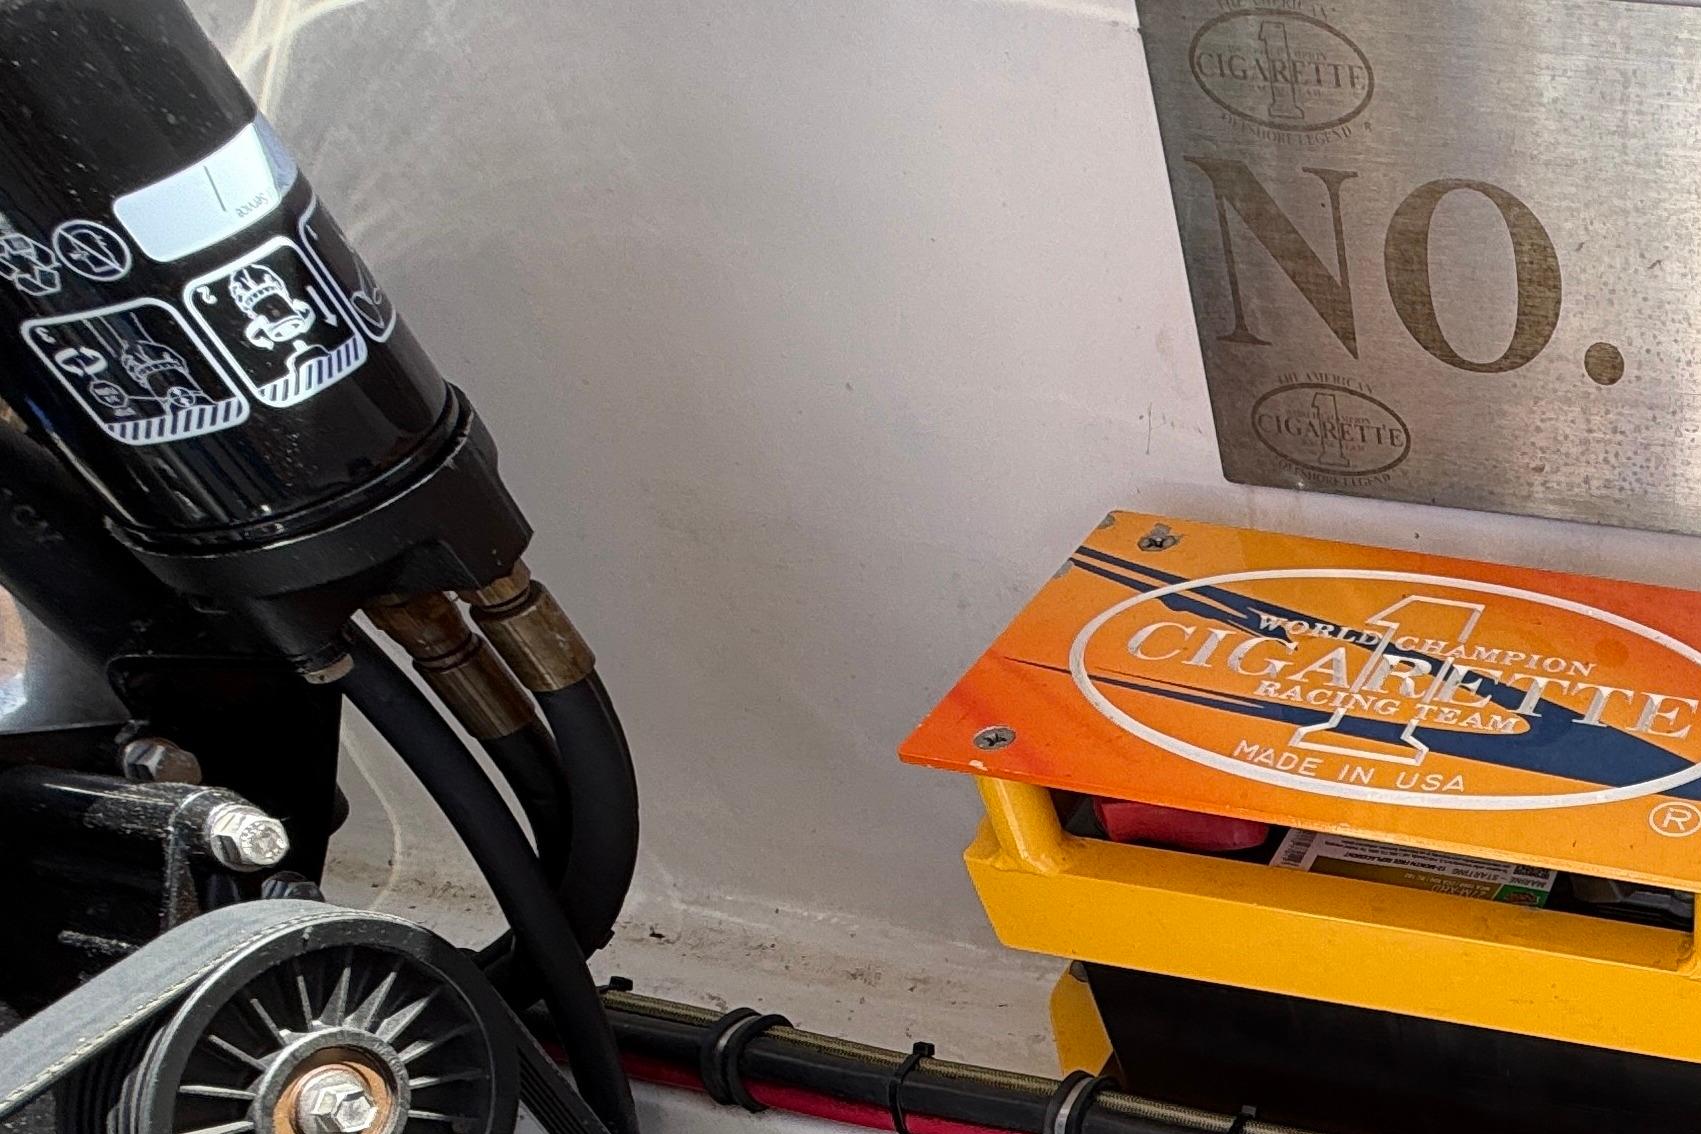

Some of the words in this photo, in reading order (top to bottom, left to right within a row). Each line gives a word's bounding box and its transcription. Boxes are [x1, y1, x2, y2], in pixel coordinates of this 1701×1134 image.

[1196, 52, 1367, 91] CIGARETTE
[1183, 156, 1626, 386] NO.
[1257, 413, 1405, 448] CIGARETTE
[1252, 609, 1386, 646] WORLD
[1395, 635, 1597, 677] CHAMPION
[1127, 621, 1700, 740] CIGARETTE
[1253, 679, 1400, 717] RACING
[1414, 701, 1519, 734] TEAM
[1233, 738, 1325, 777] MADE
[1337, 763, 1376, 785] IN
[1393, 770, 1466, 794] USA
